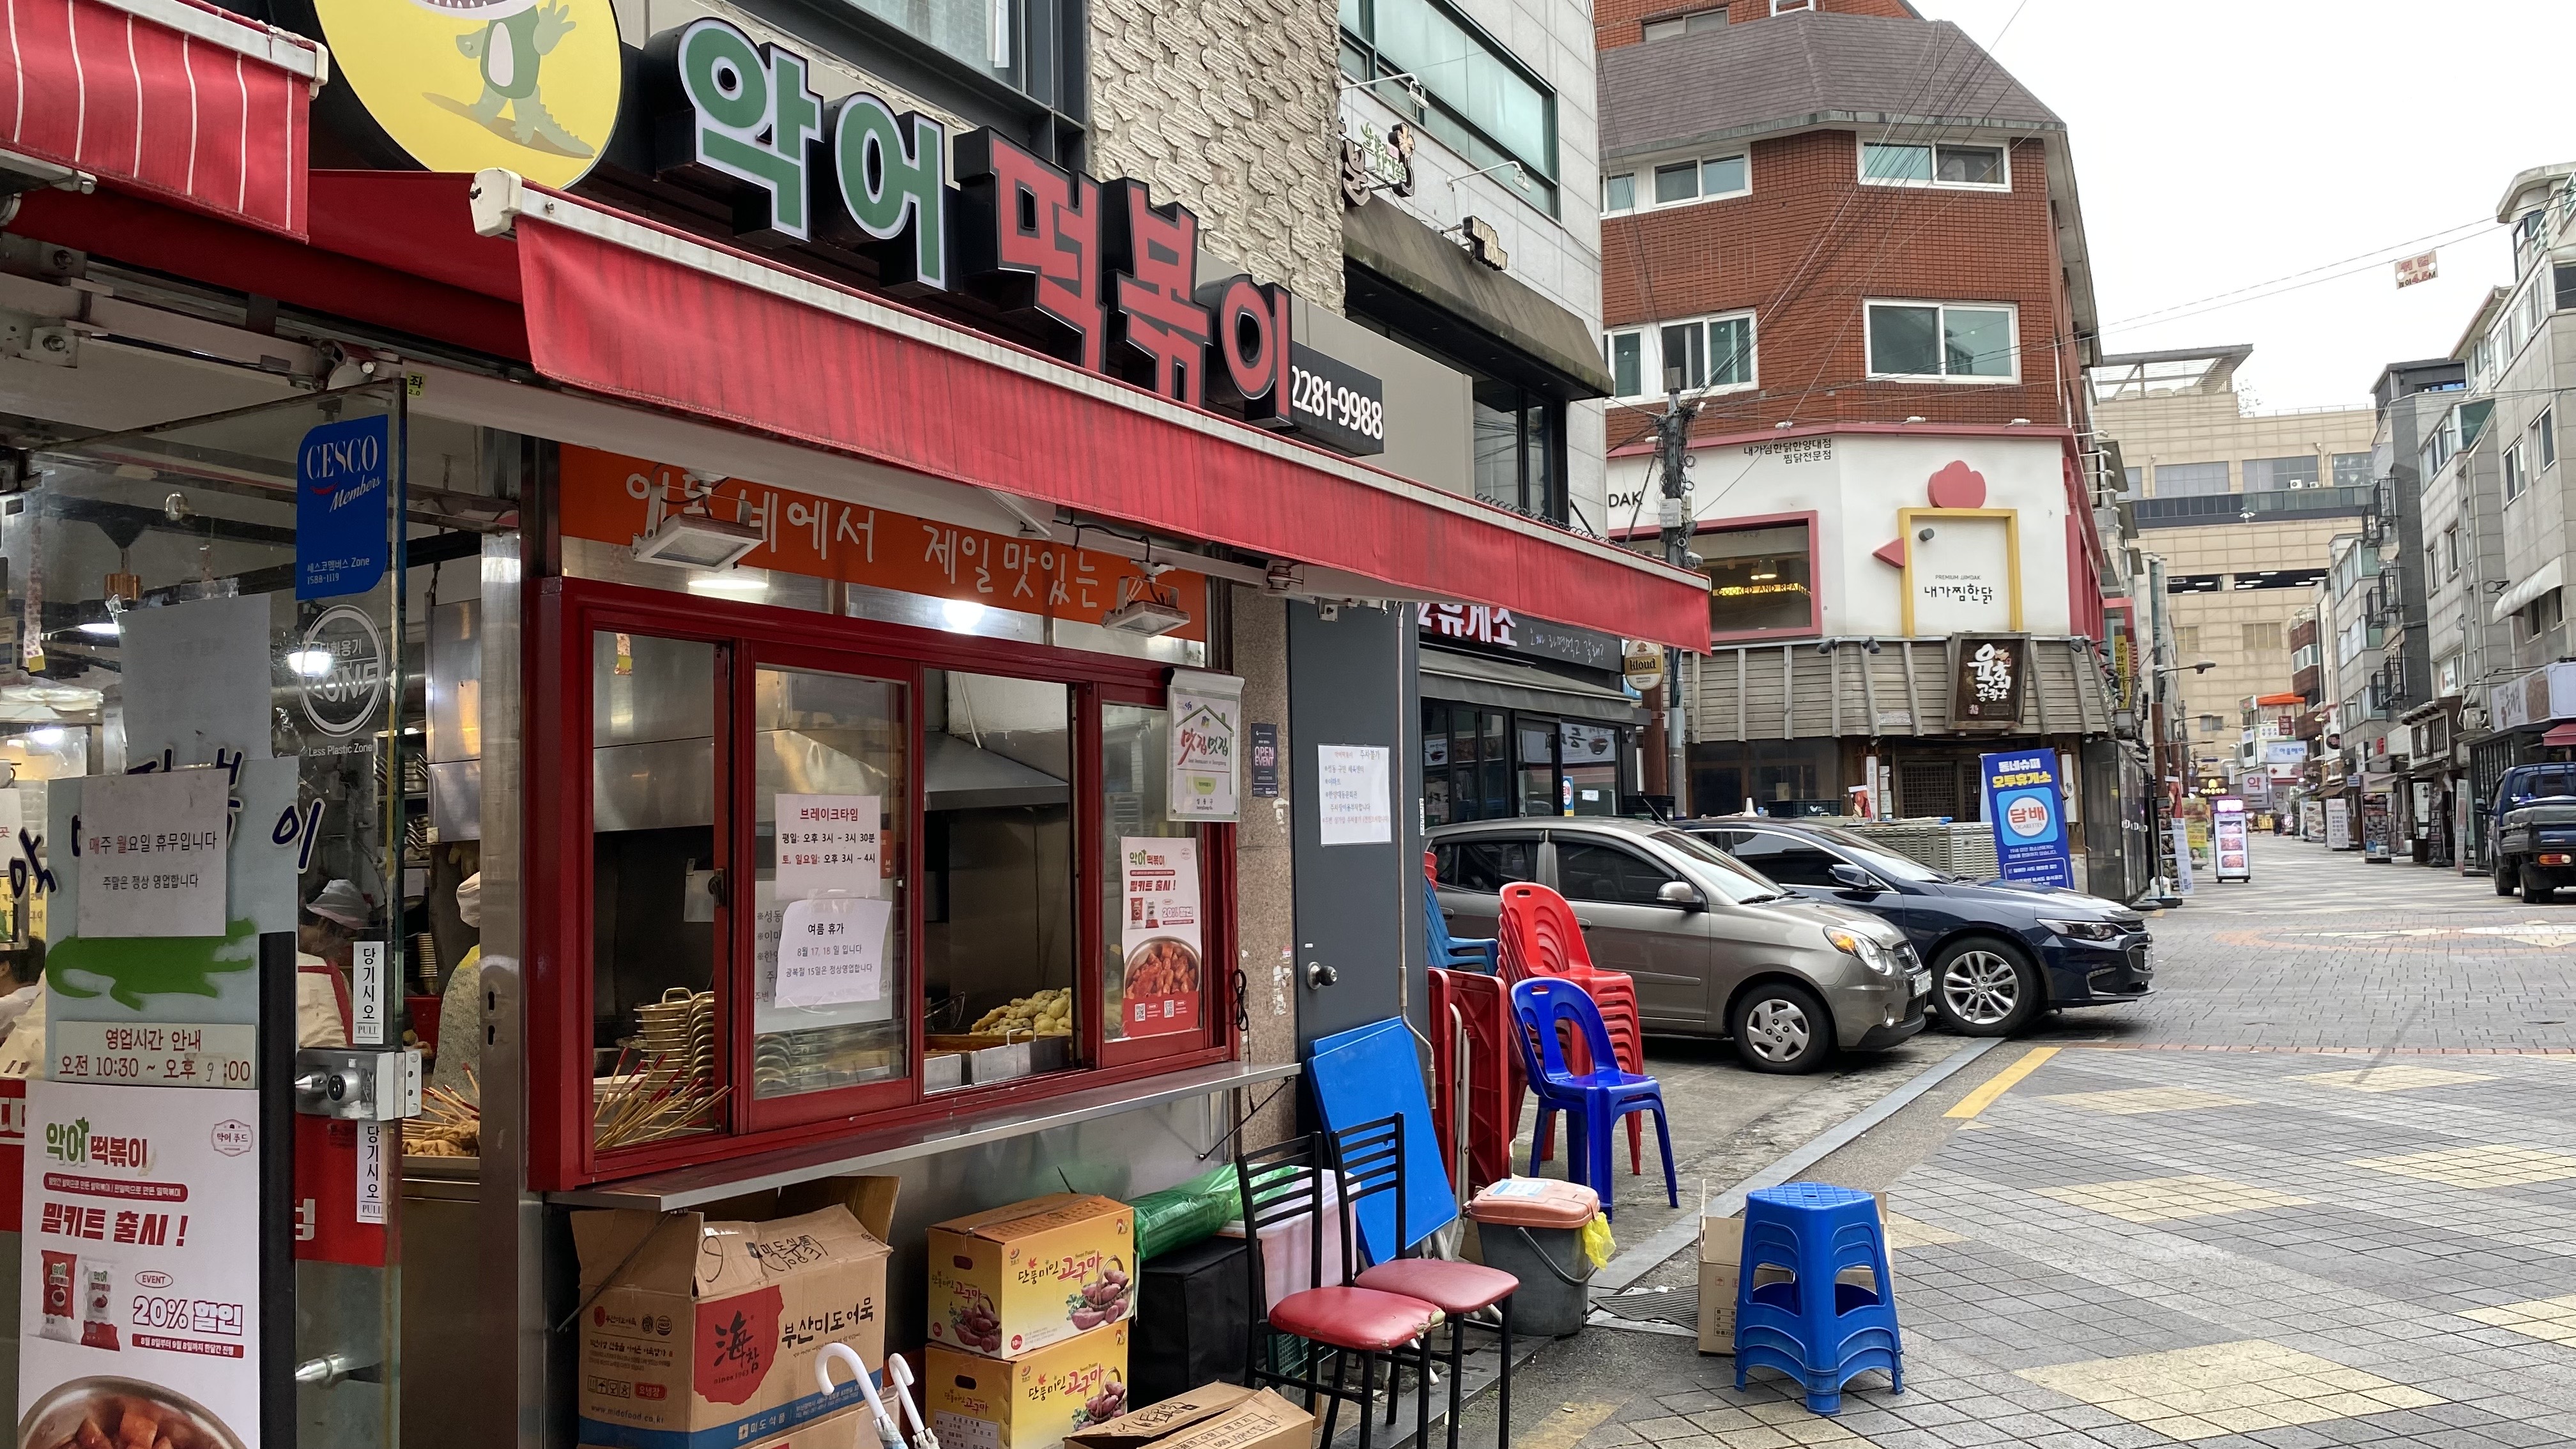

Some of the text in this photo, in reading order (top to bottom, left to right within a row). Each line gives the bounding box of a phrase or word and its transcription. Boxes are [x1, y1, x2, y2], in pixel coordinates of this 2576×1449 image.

[678, 17, 1292, 425] 악어 떡볶이
[410, 374, 424, 389] 좌
[1292, 365, 1383, 440] 2281-9988
[305, 434, 378, 480] CESCO
[1783, 449, 1832, 464] 찜닭전문점
[329, 474, 381, 513] Members
[1608, 491, 1643, 508] DAK
[351, 556, 371, 568] Zone
[307, 572, 340, 585] 1588-1119
[1717, 585, 1776, 596] COOKED AND
[1924, 583, 1993, 604] 내가찜한닭
[309, 742, 373, 757] Less Plastic Zone
[1254, 746, 1275, 757] OPEN
[1254, 756, 1275, 767] EVENT
[1998, 758, 2041, 773] 동네슈퍼
[1992, 770, 2053, 789] 오투휴게소
[2247, 776, 2261, 790] 약
[800, 808, 858, 822] 브레이크타임
[2010, 806, 2045, 824] 담배
[88, 831, 217, 854] 매주 월요일 휴무입니다
[781, 832, 800, 844] 평일:
[803, 832, 818, 843] 오후
[822, 832, 834, 843] 3시
[845, 832, 856, 843] 3시
[860, 832, 875, 843] 30분
[781, 855, 792, 865] 토,
[795, 854, 820, 864] 일요일:
[824, 854, 839, 864] 오후
[841, 854, 854, 863] 3시
[864, 853, 875, 864] 4시
[1130, 851, 1147, 866] 악어
[102, 873, 199, 891] 주말은 정상 영업합니다
[1130, 880, 1153, 892] 밀키트
[1155, 880, 1171, 891] 출시
[808, 923, 844, 935] 여름 휴가
[797, 944, 862, 957] 8월 17, 18 일 입니다
[785, 963, 873, 977] 광복절 15일은 정상영업합니다
[362, 947, 377, 1020] 당기시오
[357, 1023, 379, 1036] PULL
[105, 1028, 201, 1052] 영업시간 안내
[59, 1054, 88, 1077] 오전
[96, 1057, 139, 1078] 10:30
[163, 1055, 196, 1080] 오후
[46, 1119, 148, 1169] 악어 떡볶이
[233, 1133, 249, 1144] 푸드
[366, 1125, 379, 1199] 당기시오
[362, 1204, 384, 1214] PULL
[41, 1202, 106, 1240] 밀키트
[113, 1210, 170, 1246] 출시
[1018, 1249, 1103, 1285] 단풍미인 고구마
[141, 1275, 166, 1285] EVENT
[953, 1280, 983, 1305] 고구마
[132, 1295, 243, 1336] 20% 할인
[782, 1297, 873, 1349] 부산미도어묵
[1028, 1363, 1103, 1402] 단풍미인 고구마
[639, 1385, 660, 1398] 요냉장
[963, 1397, 989, 1416] 고구마
[1213, 1439, 1231, 1448] 500
